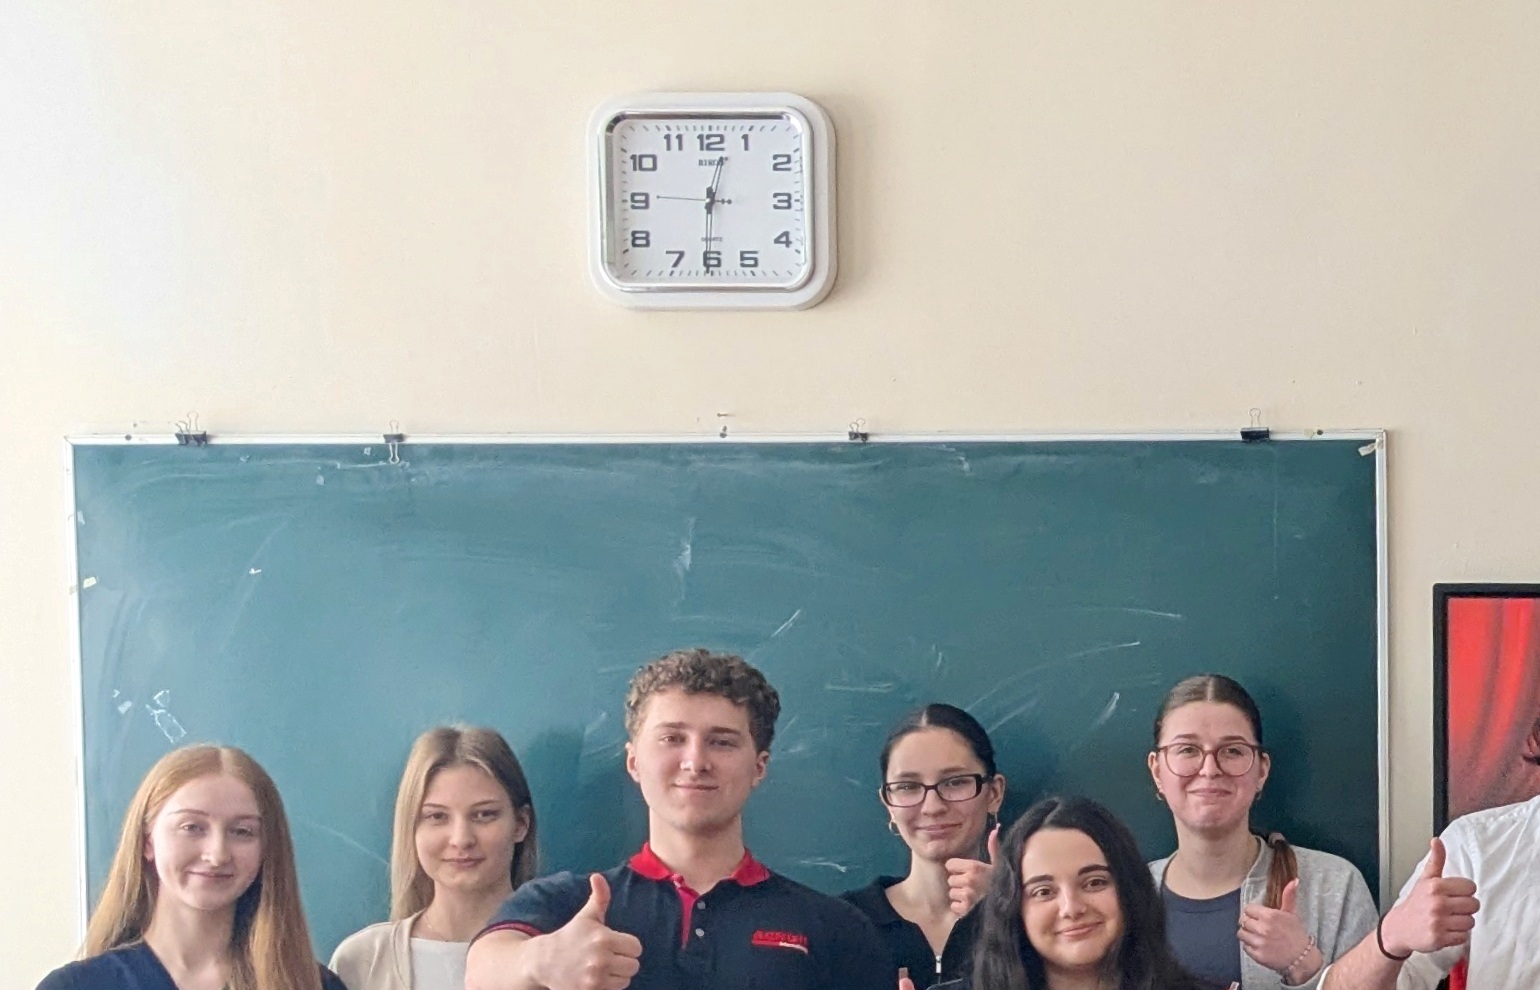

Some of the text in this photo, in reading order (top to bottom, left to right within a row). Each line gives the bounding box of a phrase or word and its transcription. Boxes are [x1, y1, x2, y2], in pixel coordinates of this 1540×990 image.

[664, 134, 683, 151] 11
[697, 134, 725, 151] 12
[741, 134, 749, 151] 1
[630, 154, 657, 171] 10
[772, 154, 792, 171] 2
[630, 192, 650, 210] 9
[772, 192, 792, 210] 3
[631, 230, 650, 248] 8
[773, 231, 792, 248] 4
[665, 251, 685, 268] 7
[703, 251, 721, 268] 6
[739, 251, 759, 268] 5
